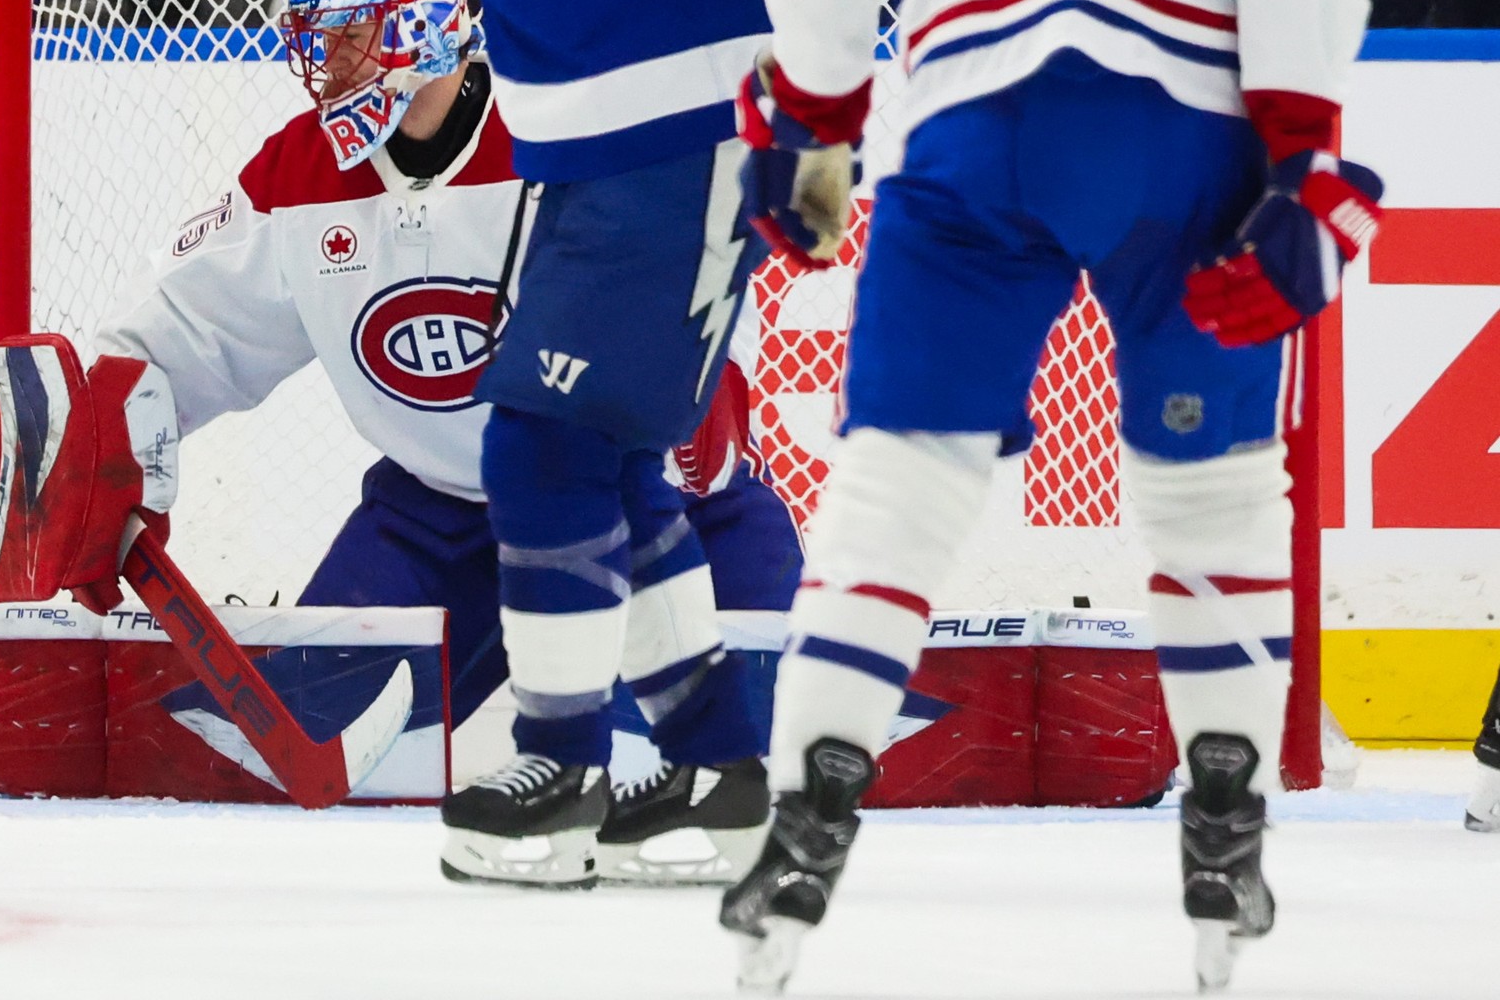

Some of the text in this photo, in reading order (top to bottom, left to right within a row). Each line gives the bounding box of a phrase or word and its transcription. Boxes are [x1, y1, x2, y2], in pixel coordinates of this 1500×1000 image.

[109, 611, 165, 629] TR
[928, 618, 1026, 638] RUE
[132, 543, 277, 738] TRUE
